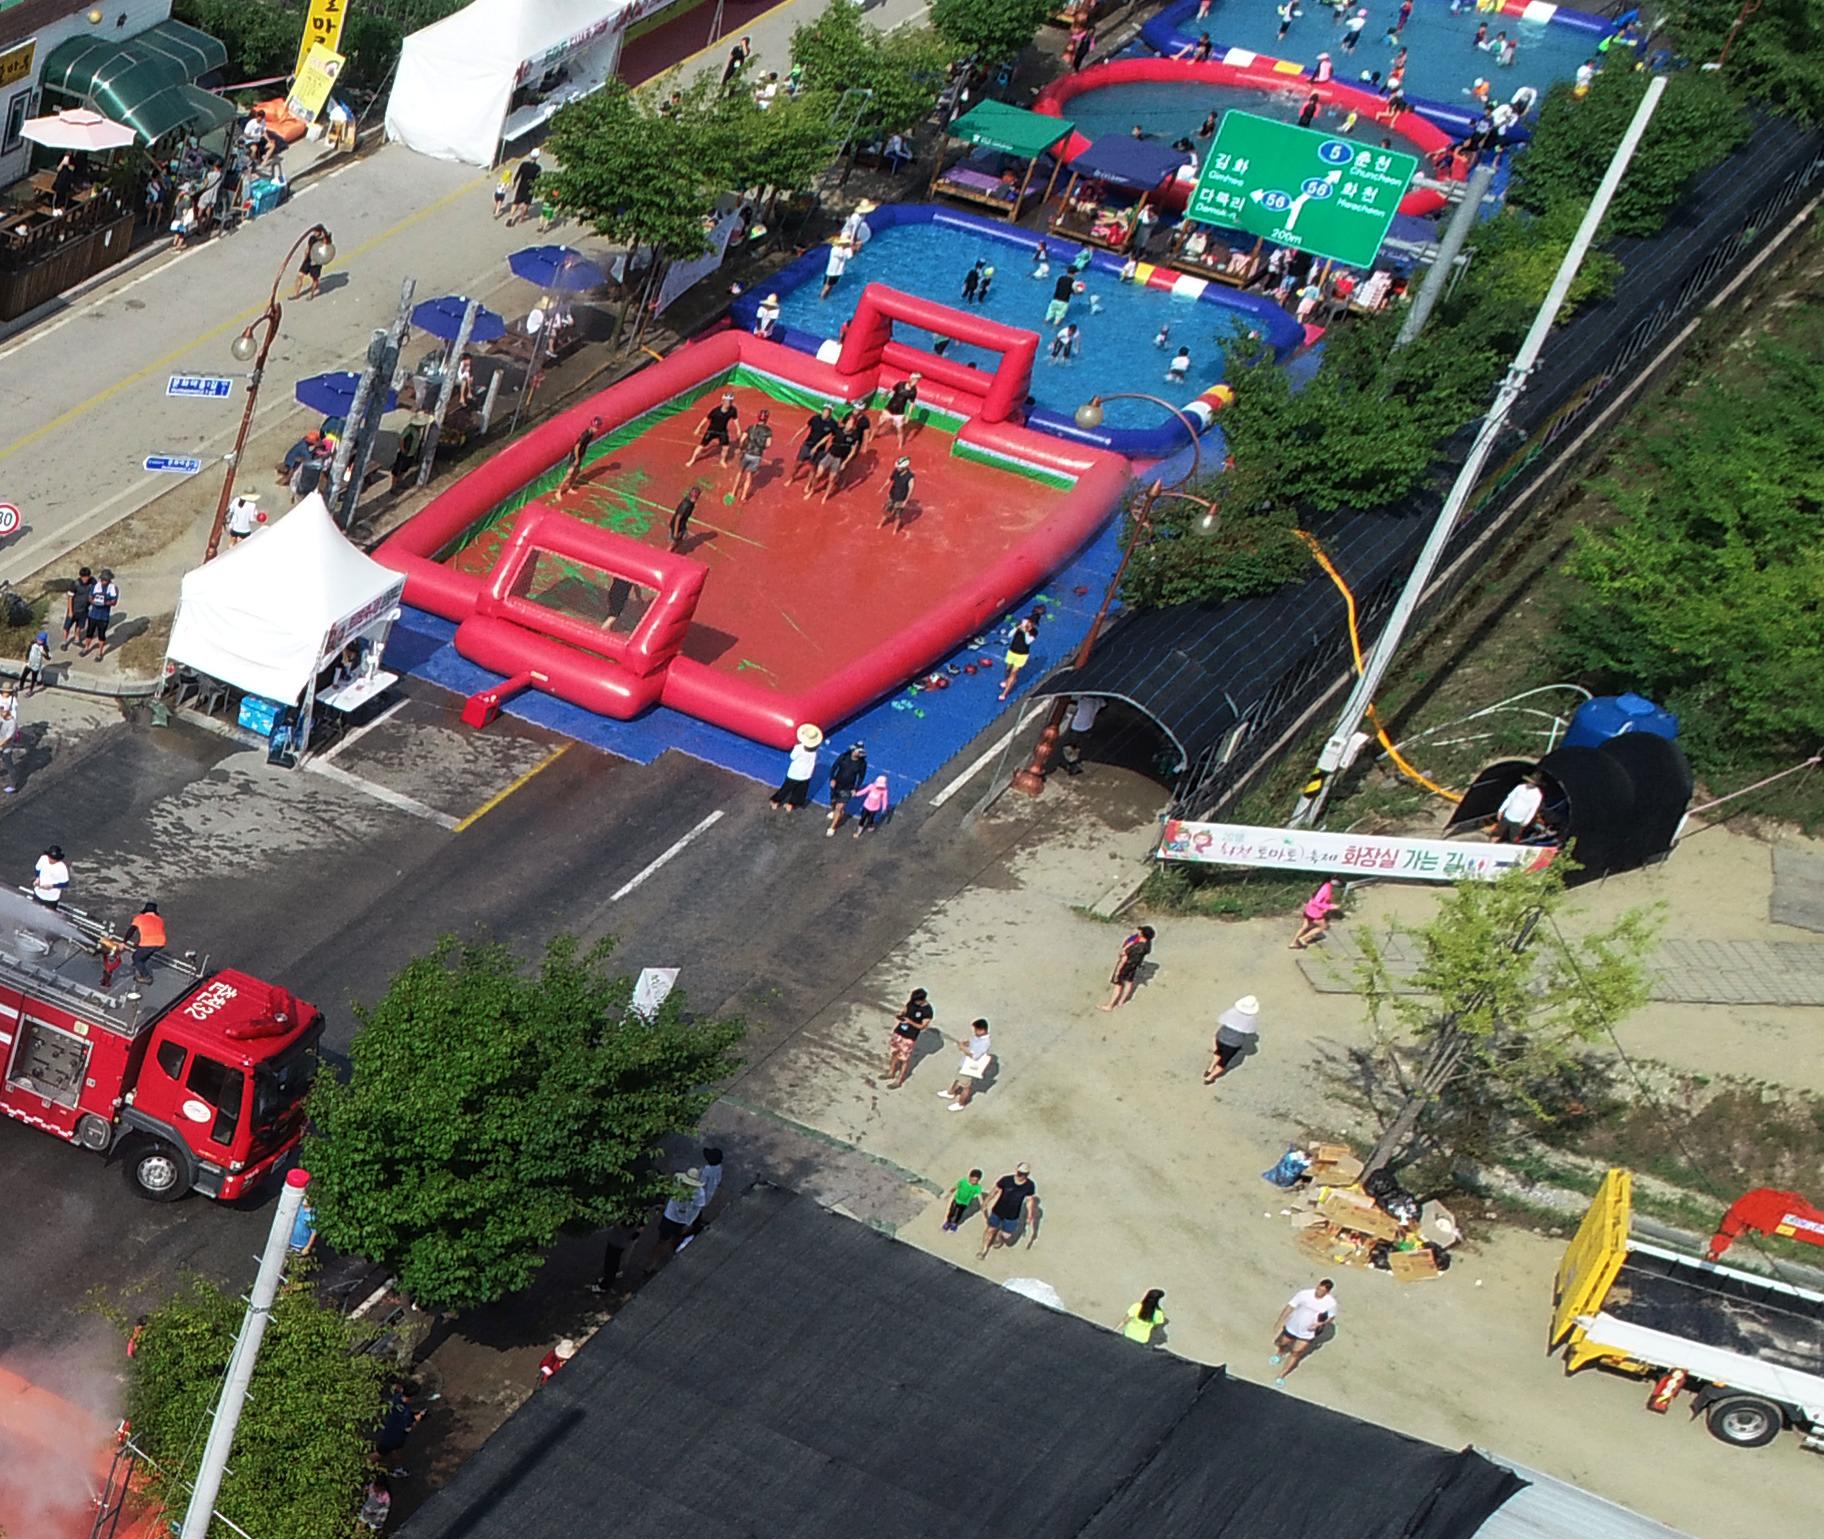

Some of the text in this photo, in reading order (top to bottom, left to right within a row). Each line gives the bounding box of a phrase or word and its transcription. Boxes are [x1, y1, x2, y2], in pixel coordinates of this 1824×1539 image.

[1330, 146, 1343, 160] 5
[1355, 151, 1394, 172] 춘천
[1215, 154, 1250, 175] 김화
[1199, 188, 1246, 211] 다목리
[1308, 182, 1327, 196] 56
[1340, 182, 1379, 204] 화천
[1267, 194, 1285, 208] 56
[1270, 228, 1302, 245] 200m
[1255, 847, 1298, 863] 토마토
[1342, 845, 1400, 869] 화장실
[1403, 849, 1439, 872] 가는
